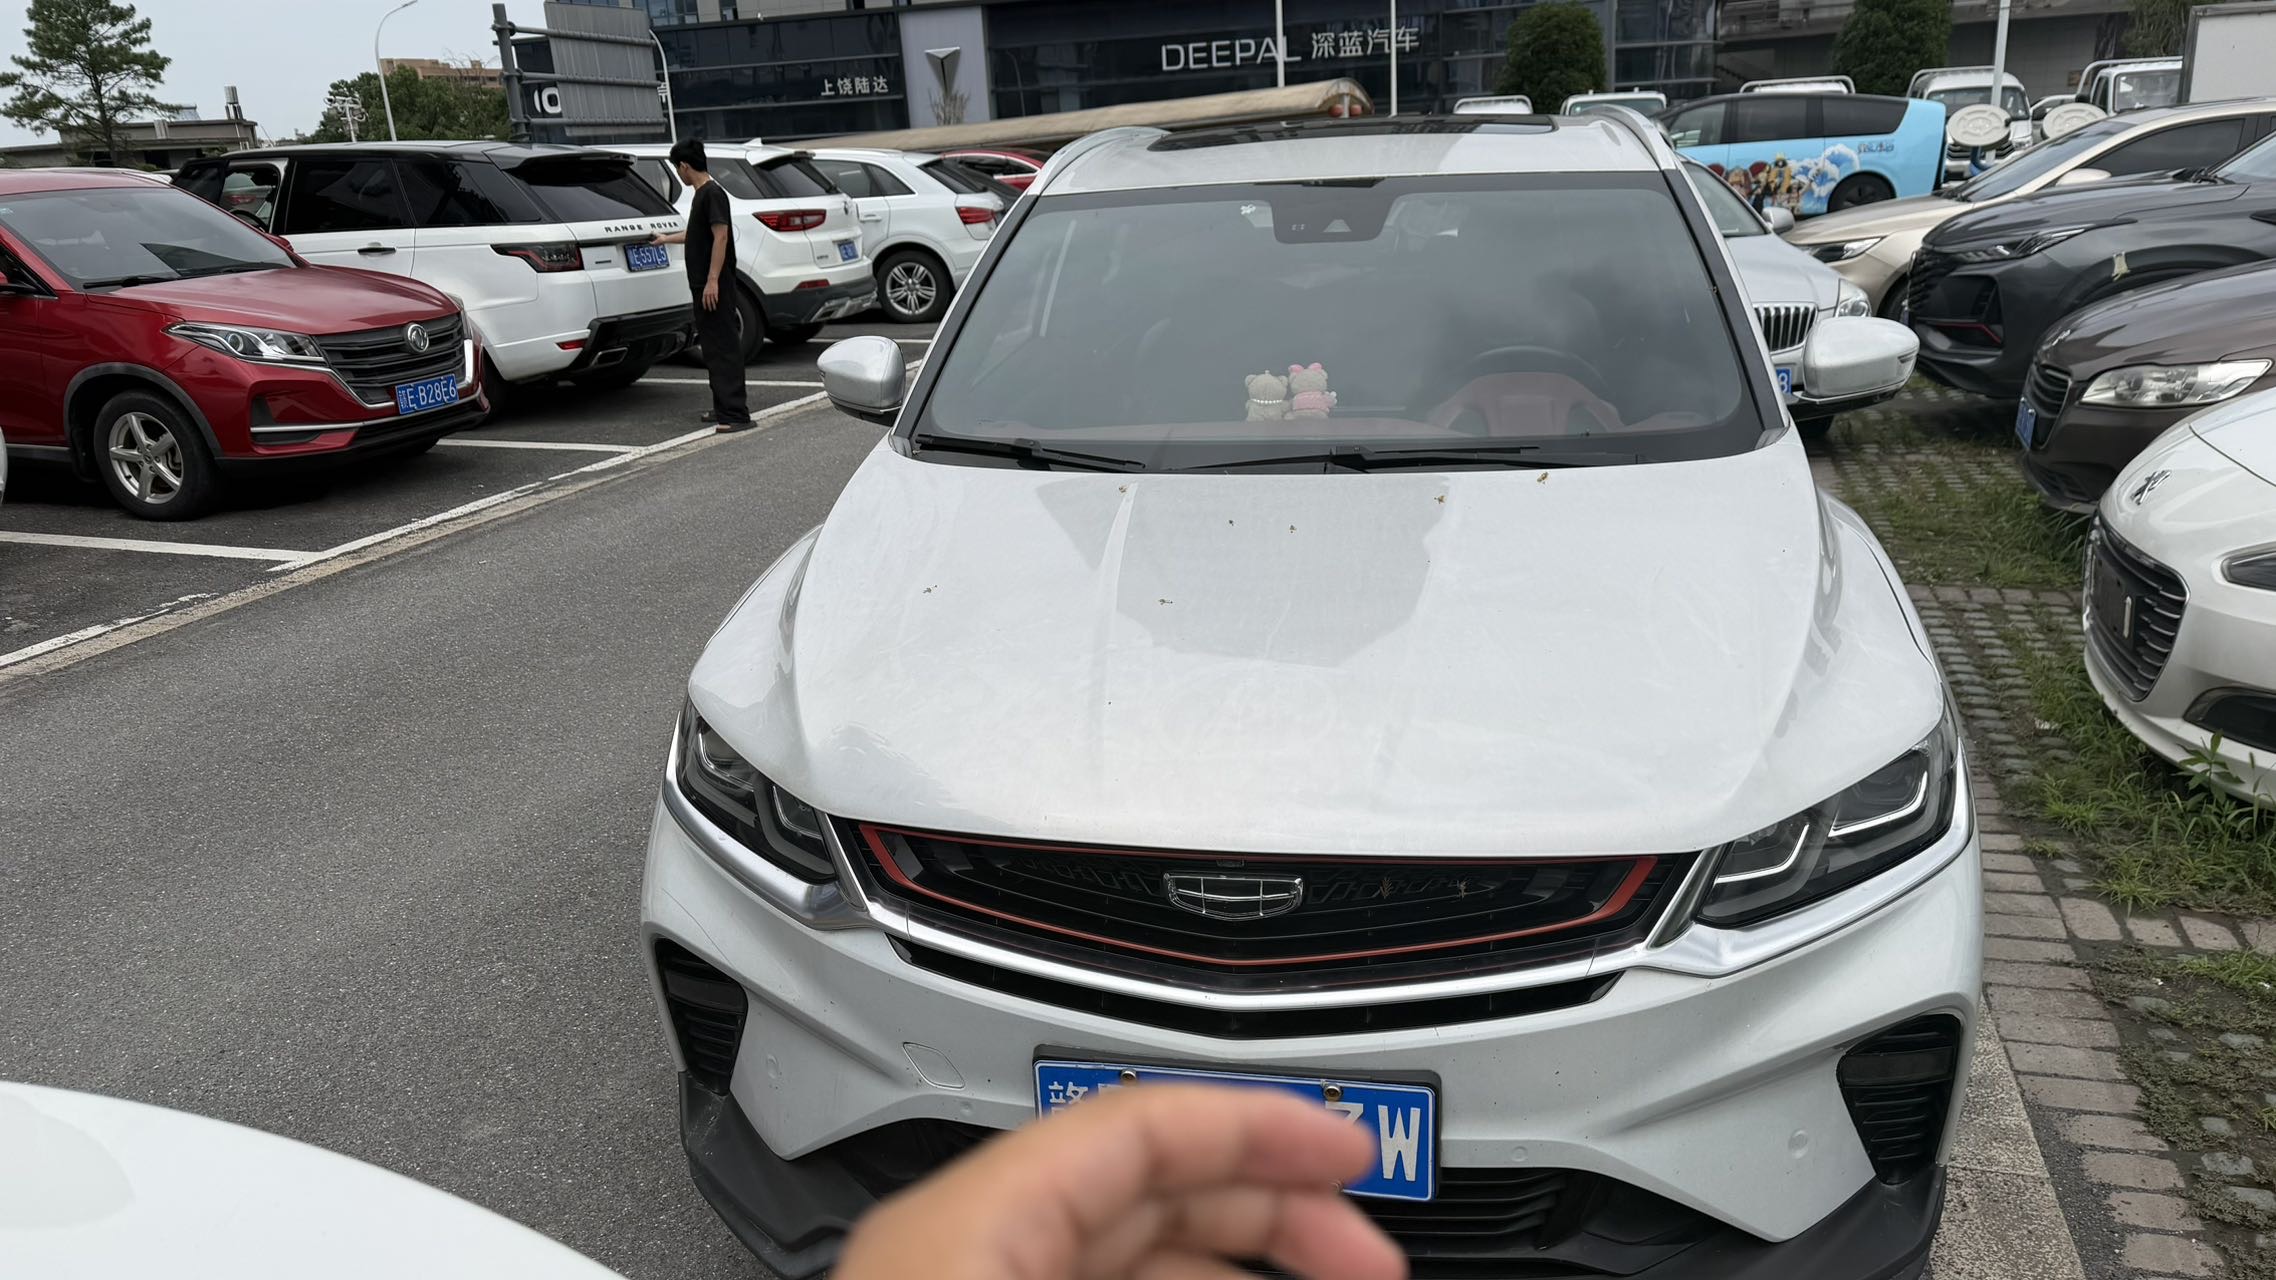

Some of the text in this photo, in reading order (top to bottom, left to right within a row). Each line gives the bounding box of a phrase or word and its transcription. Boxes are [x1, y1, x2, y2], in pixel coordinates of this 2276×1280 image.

[1161, 36, 1302, 71] DEEPAL
[1311, 25, 1420, 59] 深蓝汽车
[820, 75, 889, 96] 上饶陆达
[604, 220, 679, 233] RANGE ROVER
